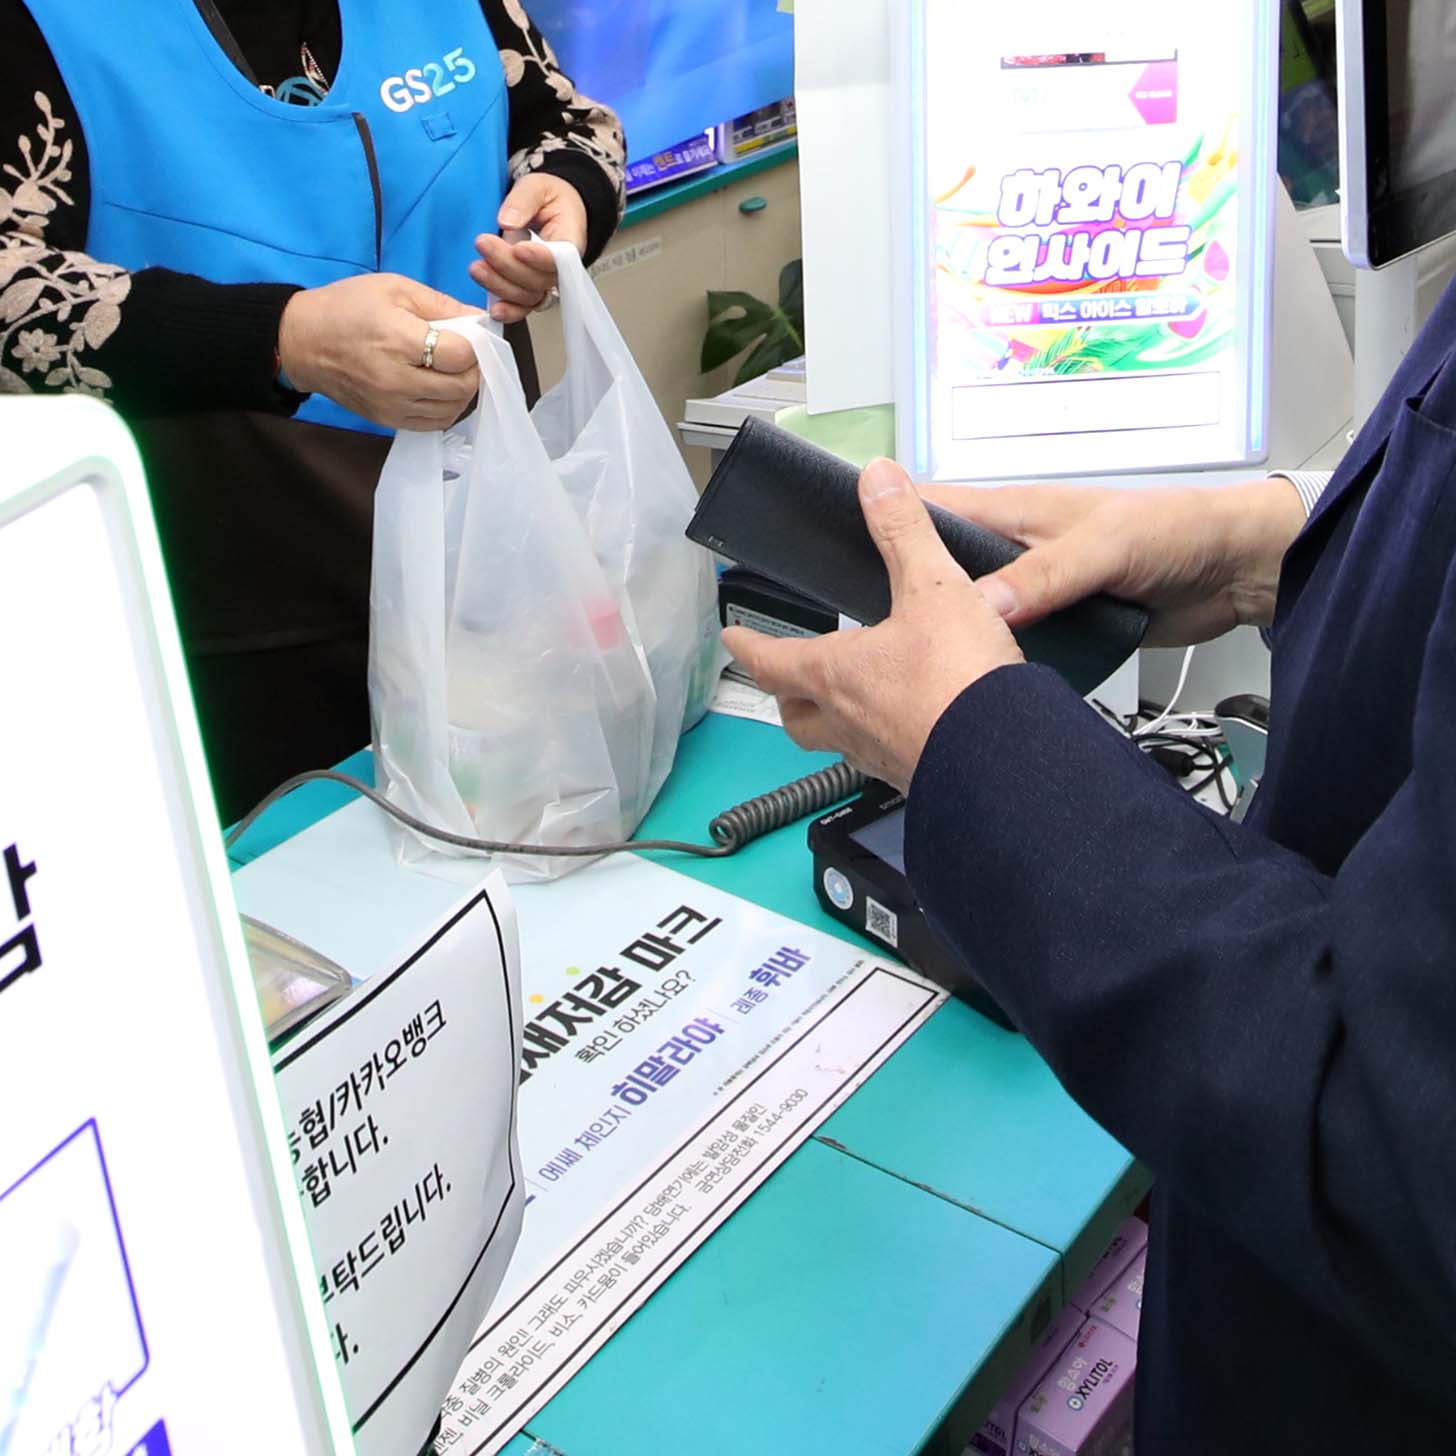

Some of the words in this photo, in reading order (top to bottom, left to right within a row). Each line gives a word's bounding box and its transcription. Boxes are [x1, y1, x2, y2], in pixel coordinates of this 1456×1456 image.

[379, 48, 477, 113] GS25
[997, 160, 1184, 228] 하와이
[1079, 299, 1133, 319] 아이스
[519, 965, 643, 1086] 새저감
[619, 904, 724, 973] 마크
[573, 1028, 625, 1065] 확인
[615, 968, 697, 1035] 하셨나요?
[573, 1103, 633, 1149] 체인지
[610, 1016, 727, 1107] 히말라야
[747, 944, 813, 989] 휘바
[300, 1114, 389, 1208] 합니다.
[458, 1397, 493, 1427] 비닐
[620, 1204, 693, 1267] 들어있습니다.
[694, 1134, 760, 1195] 금연상담전화
[752, 1087, 810, 1138] 1544-9030
[460, 1356, 505, 1397] 질병의
[527, 1292, 570, 1331] 그래도
[563, 1214, 650, 1295] 피우시겠습니까?
[643, 1156, 710, 1218] 담배연기에는
[1074, 1357, 1114, 1400] XYLITOL
